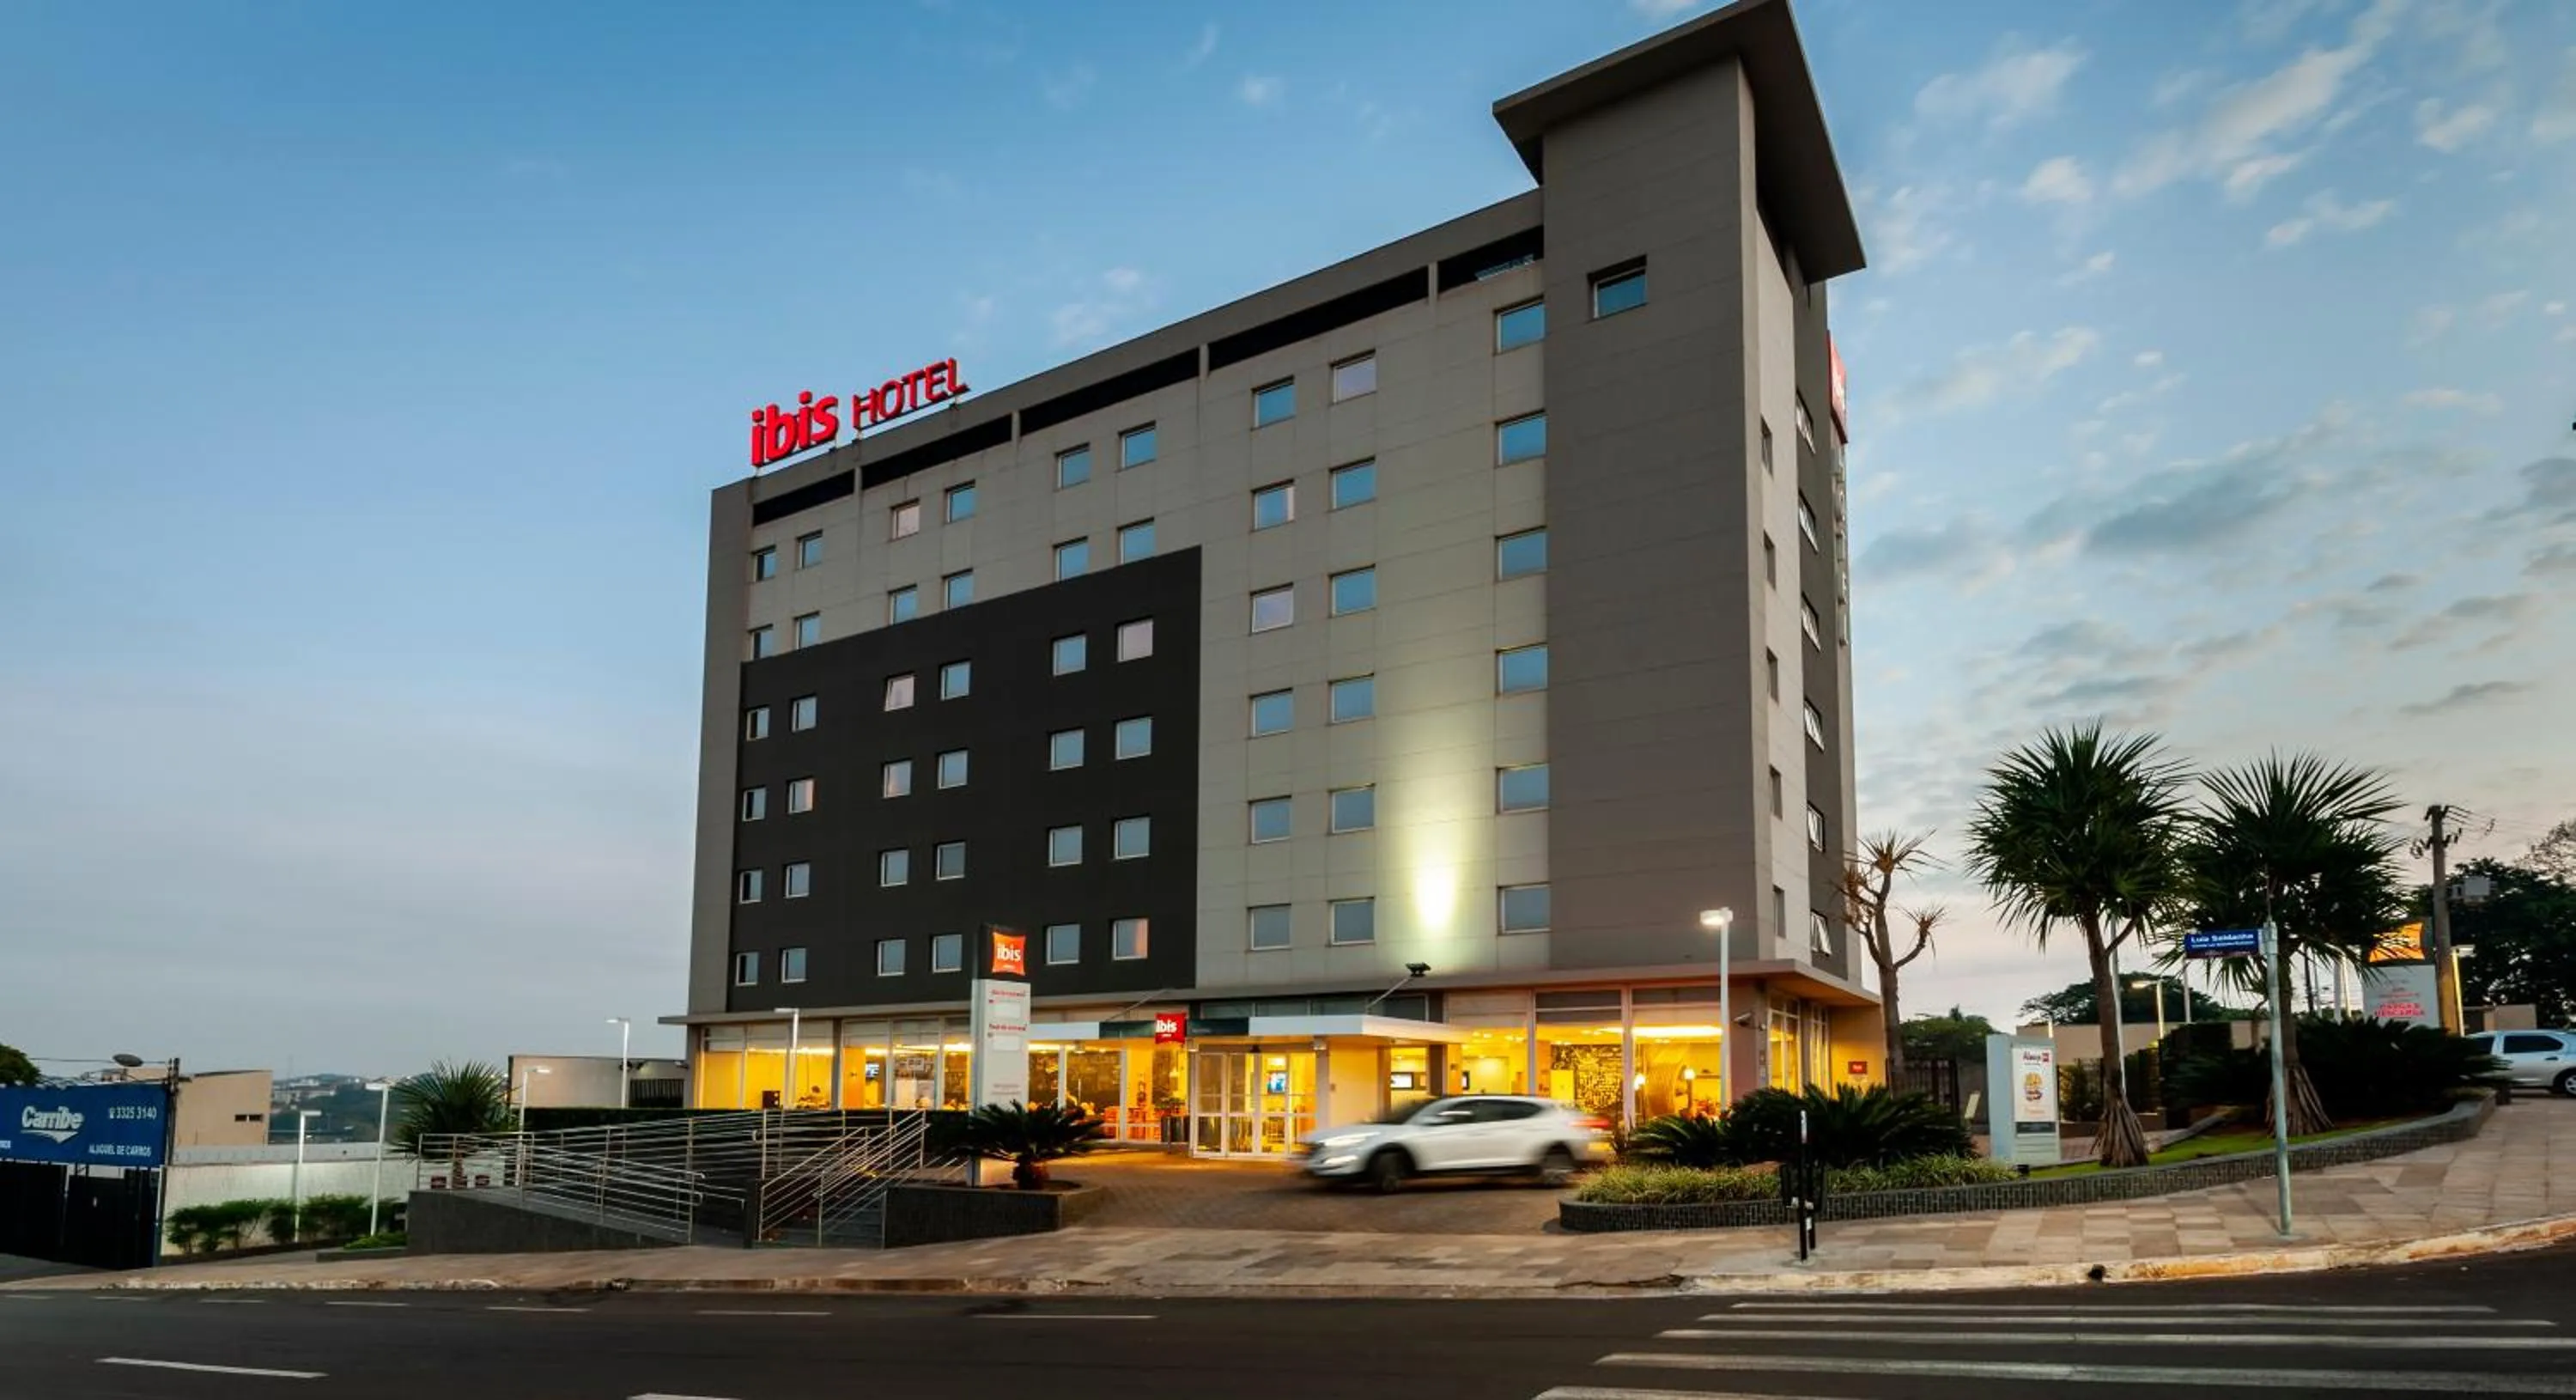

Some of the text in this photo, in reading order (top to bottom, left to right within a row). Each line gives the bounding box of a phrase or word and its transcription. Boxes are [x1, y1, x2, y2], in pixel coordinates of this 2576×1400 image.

[751, 357, 970, 467] ibis HOTEL
[997, 943, 1021, 962] ibis
[1155, 1020, 1177, 1032] ibis
[137, 1105, 157, 1120] 3140
[116, 1145, 125, 1155] DE
